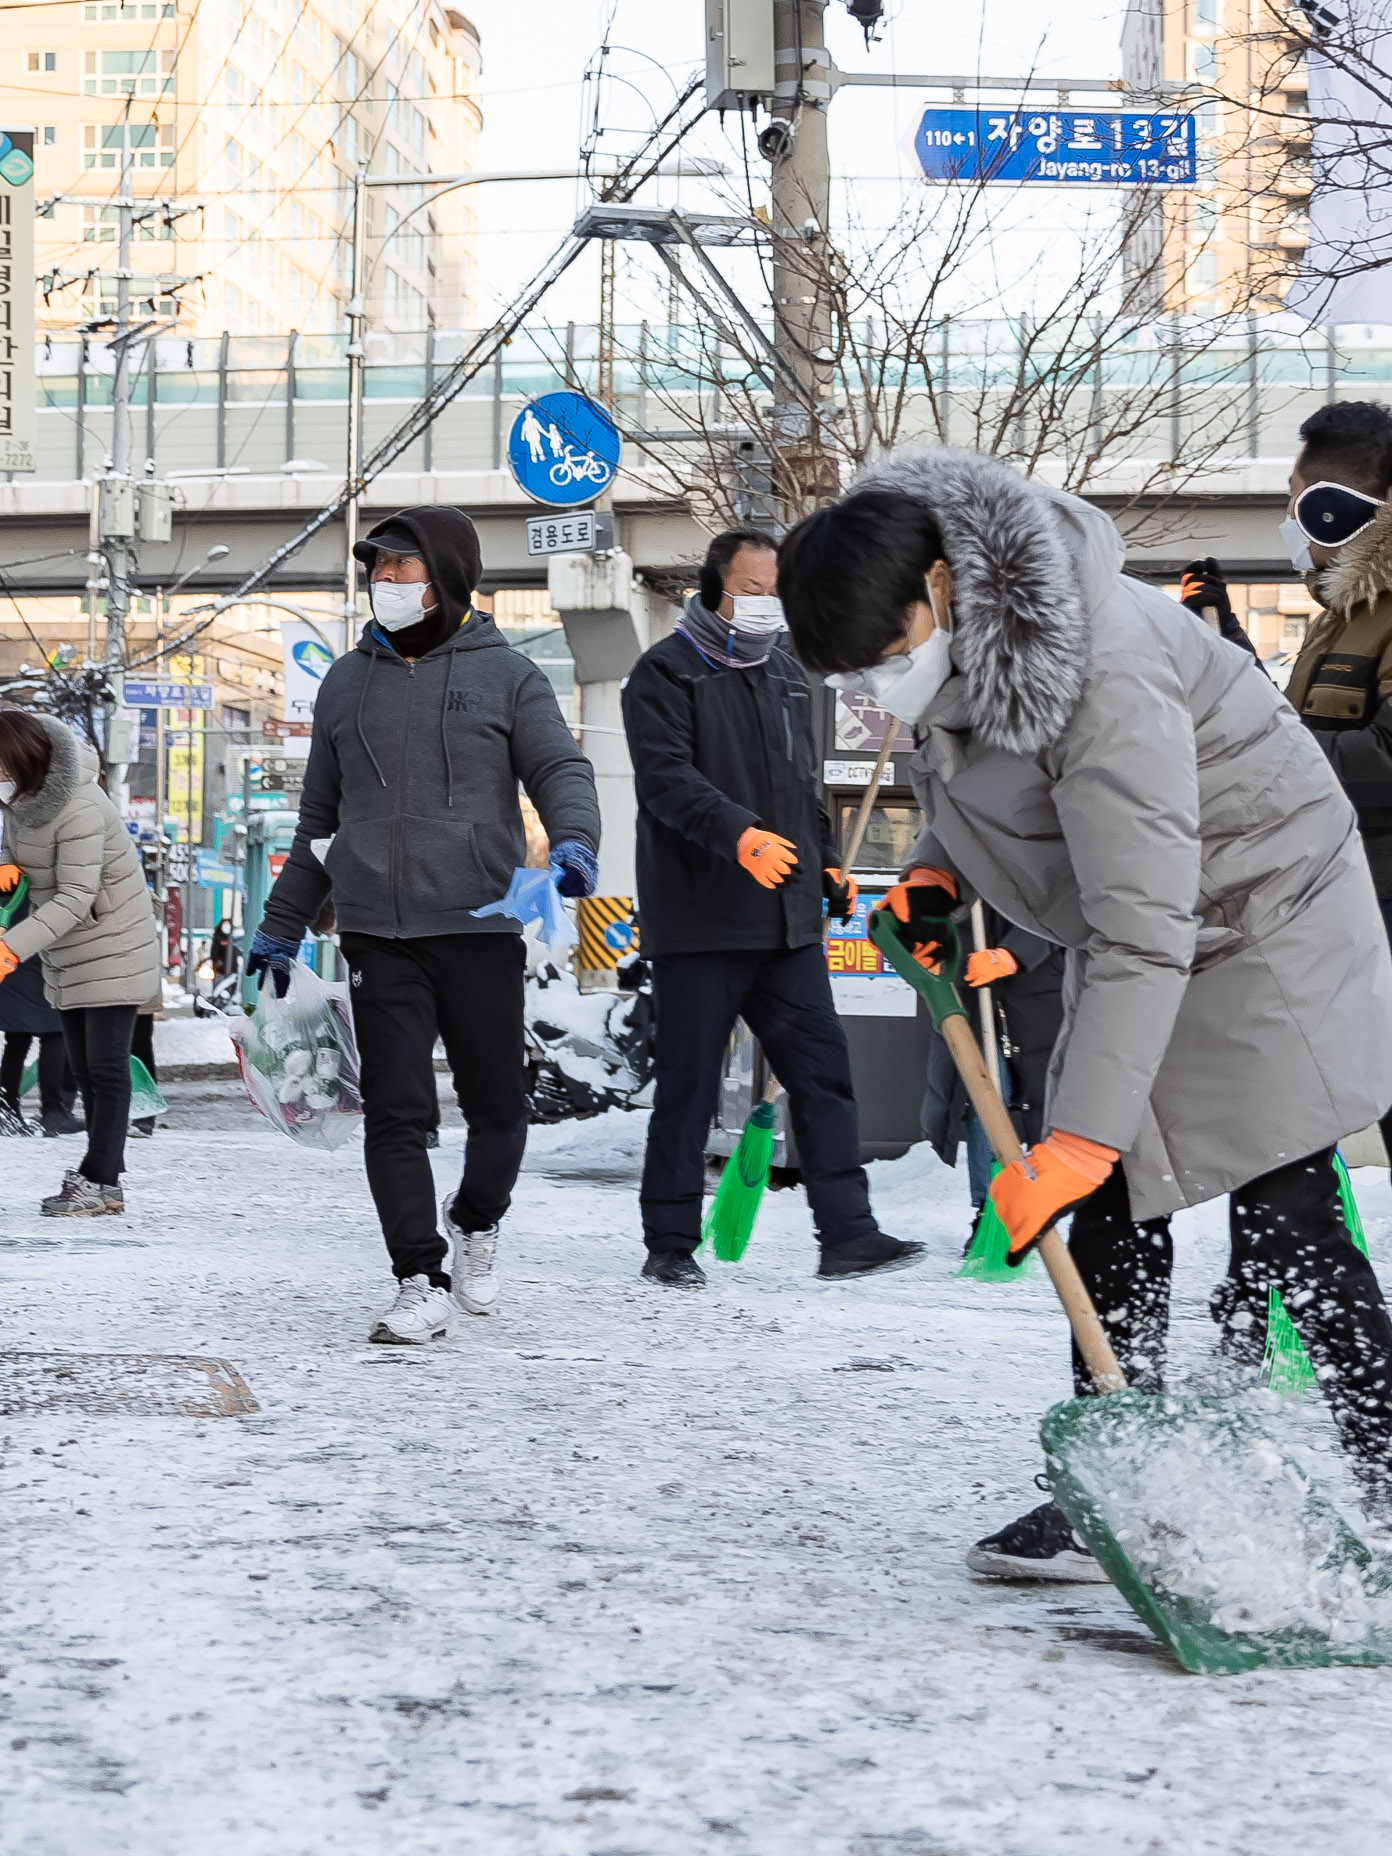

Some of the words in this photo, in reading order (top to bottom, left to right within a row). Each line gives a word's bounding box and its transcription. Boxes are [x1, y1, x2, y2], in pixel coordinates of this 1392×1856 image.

[925, 130, 951, 147] 110
[1037, 158, 1131, 181] Jayang-ro
[1138, 158, 1191, 180] 13-gil
[531, 522, 590, 549] 겸용도로
